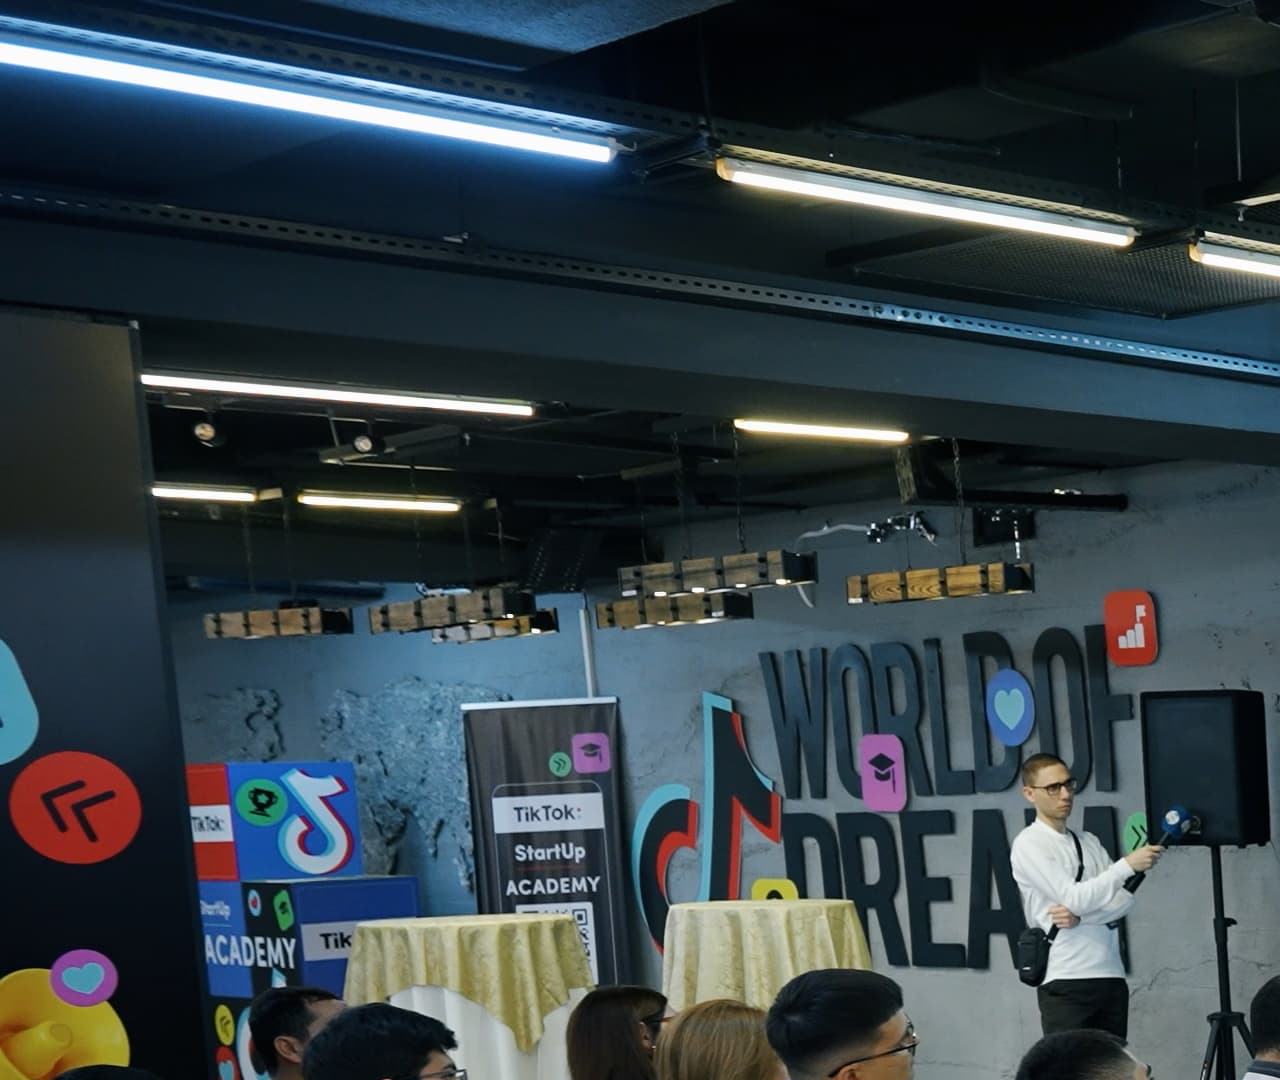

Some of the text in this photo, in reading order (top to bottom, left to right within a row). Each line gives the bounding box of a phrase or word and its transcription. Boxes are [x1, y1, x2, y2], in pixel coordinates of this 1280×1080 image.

[758, 624, 1134, 801] WORLD OF
[515, 842, 587, 864] StartUp
[506, 876, 601, 896] ACADEMY
[783, 805, 1132, 975] DREA
[204, 933, 297, 969] ACADEMY
